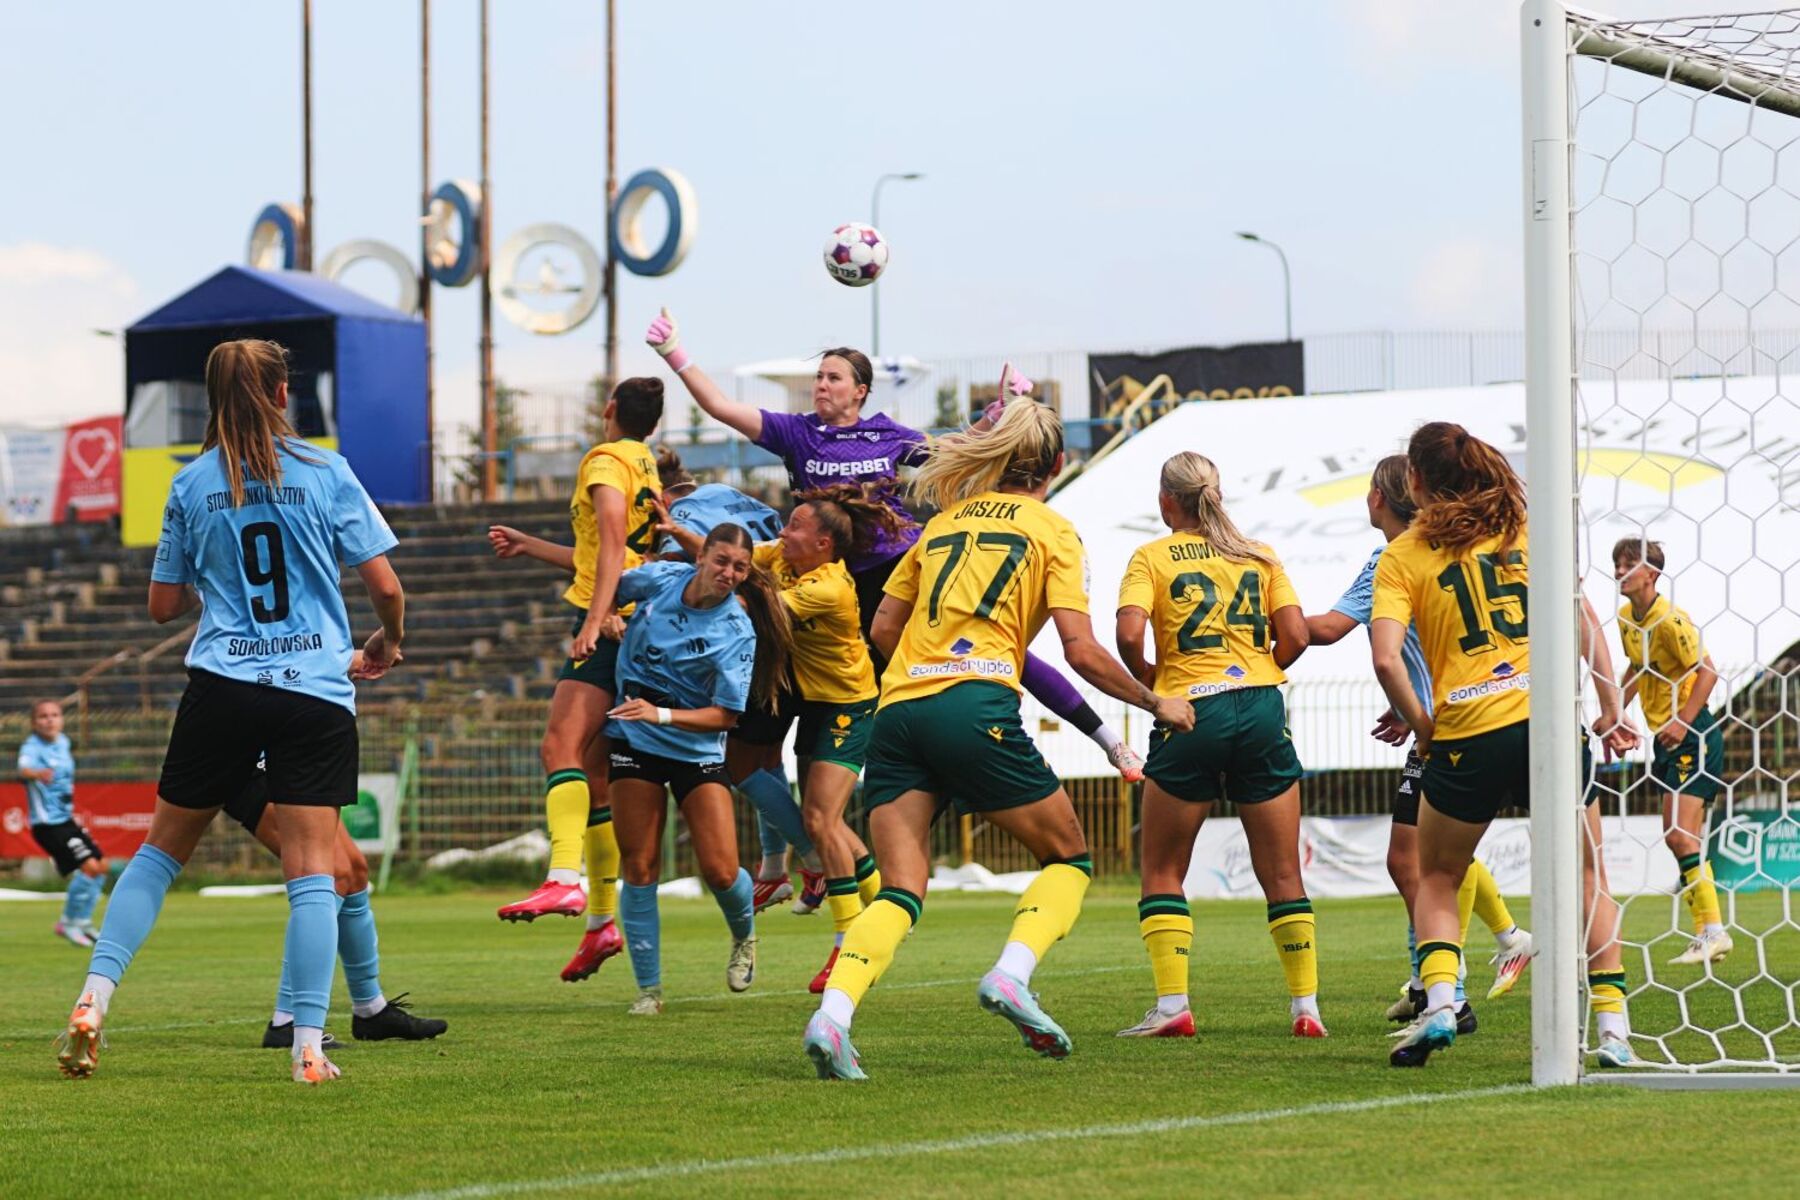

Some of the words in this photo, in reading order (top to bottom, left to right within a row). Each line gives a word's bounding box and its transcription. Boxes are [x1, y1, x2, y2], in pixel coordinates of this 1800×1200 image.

[805, 457, 890, 476] SUPERBET
[954, 501, 1022, 521] JASZEK
[240, 521, 290, 624] 9
[925, 531, 1036, 628] 77
[1169, 571, 1272, 655] 24
[1437, 550, 1528, 656] 15
[228, 633, 323, 656] SOKOŁOWSKA
[911, 660, 1013, 676] zondacrypto
[1450, 676, 1531, 701] zondacry
[1282, 941, 1310, 952] 1964
